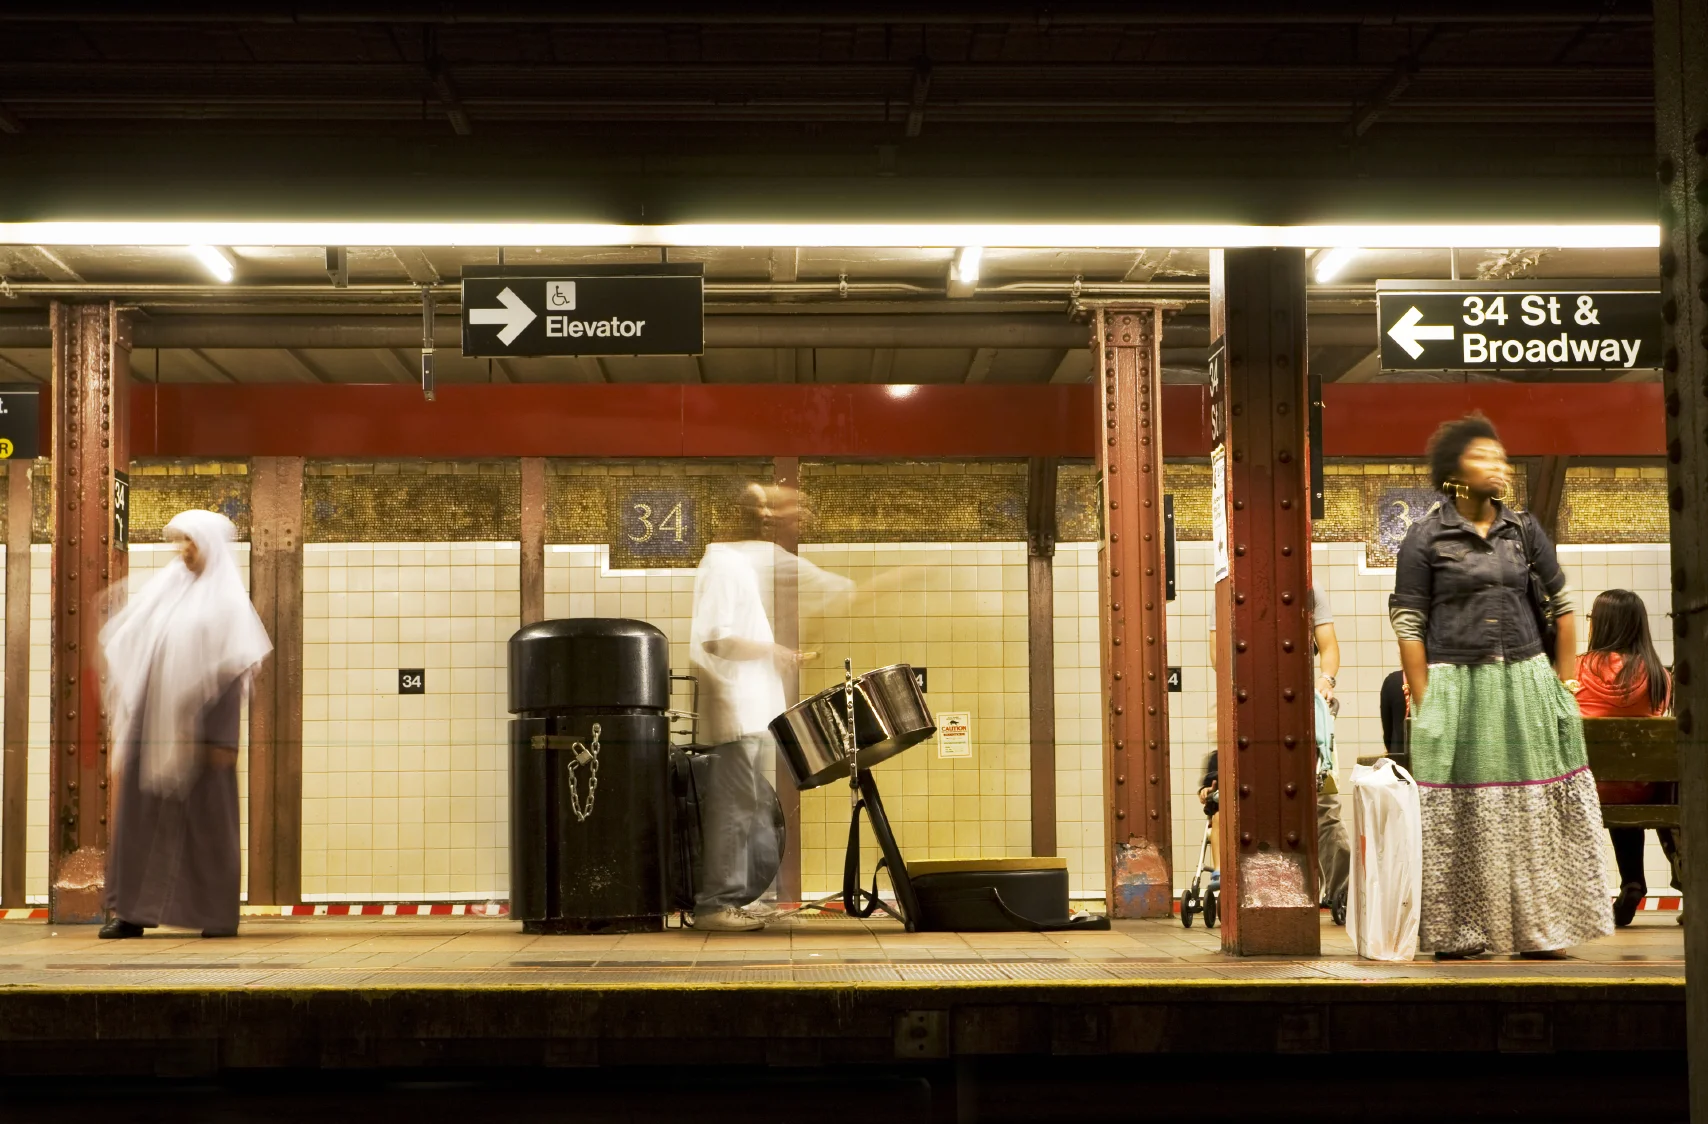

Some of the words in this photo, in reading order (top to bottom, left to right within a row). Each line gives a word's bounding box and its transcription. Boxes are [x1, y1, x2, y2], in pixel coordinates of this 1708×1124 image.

[546, 315, 646, 337] Elevator
[1463, 295, 1508, 326] 34
[1521, 295, 1561, 326] St
[1574, 295, 1600, 326] &
[1463, 333, 1641, 368] Broadway
[1209, 357, 1219, 398] 34
[115, 481, 125, 511] 34
[628, 501, 688, 542] 34
[402, 675, 422, 688] 34
